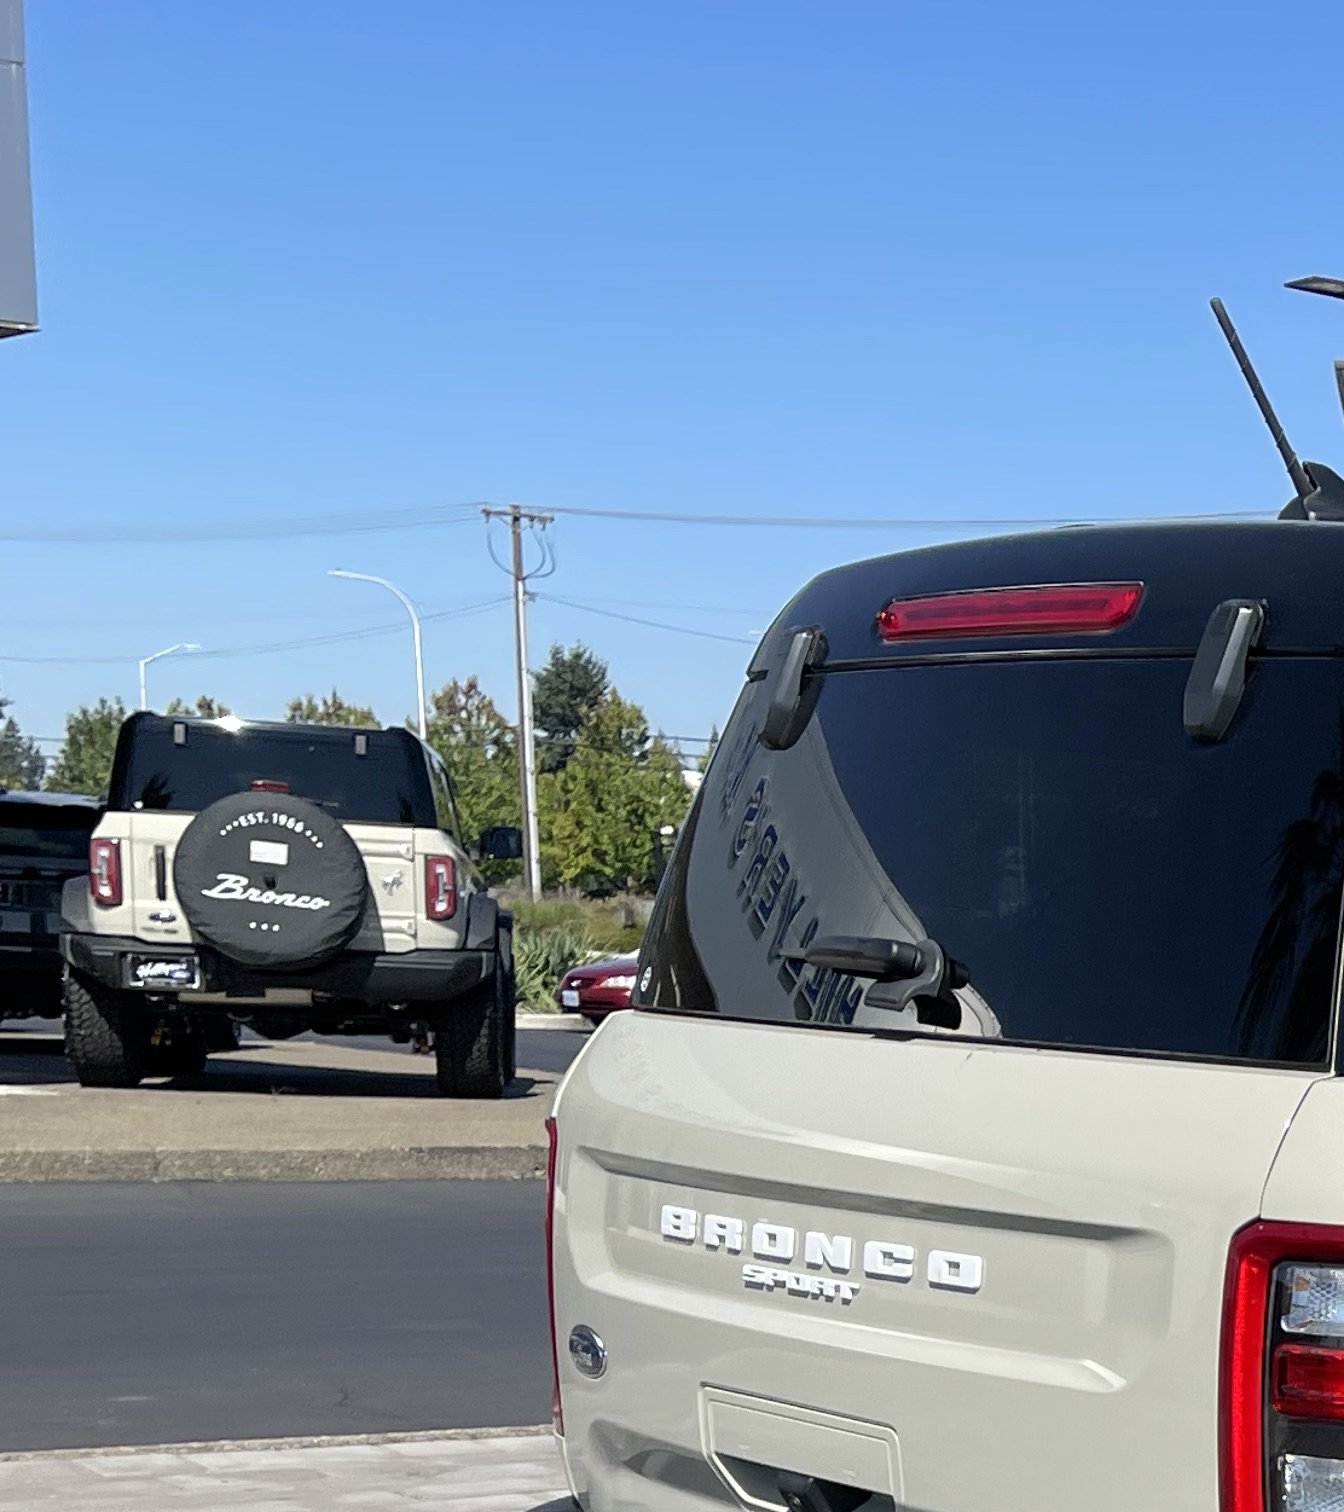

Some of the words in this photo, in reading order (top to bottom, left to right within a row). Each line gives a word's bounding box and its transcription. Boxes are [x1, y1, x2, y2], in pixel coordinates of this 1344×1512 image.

[201, 873, 330, 910] Bronco
[661, 1204, 984, 1293] BRONCO
[742, 1263, 861, 1304] SPORT
